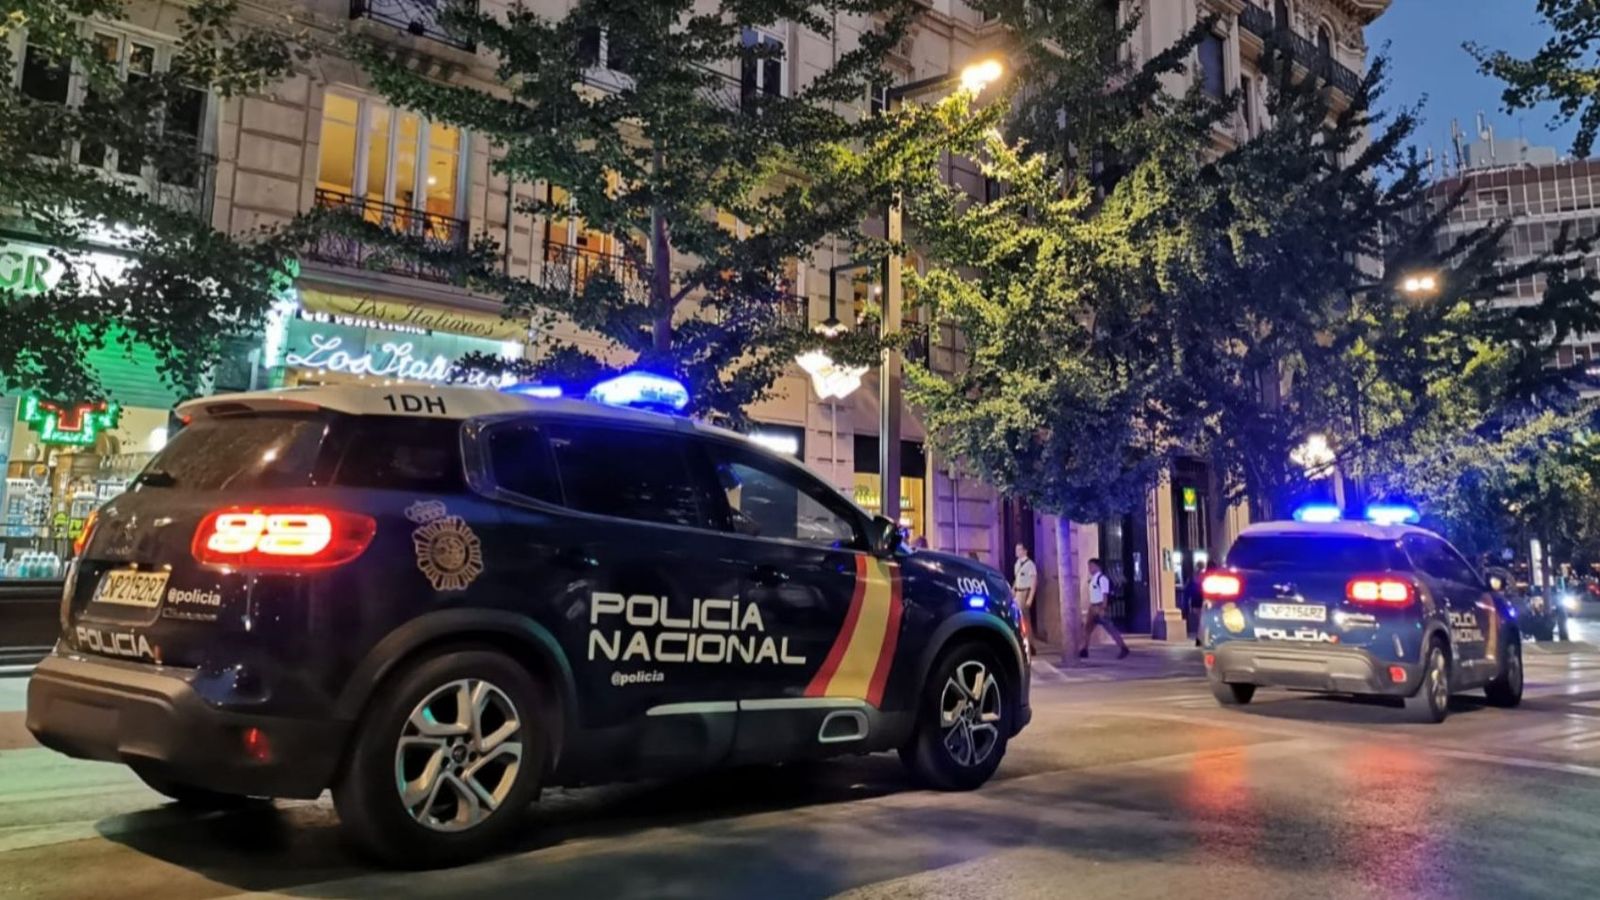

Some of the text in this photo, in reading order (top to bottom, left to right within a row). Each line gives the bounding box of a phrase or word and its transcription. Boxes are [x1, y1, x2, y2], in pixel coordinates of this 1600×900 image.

[336, 295, 494, 337] Los Italianos
[286, 333, 376, 376] Los
[384, 394, 447, 415] 1DH
[168, 587, 221, 606] @policia
[590, 592, 765, 632] POLICÍA
[75, 625, 155, 659] POLICÍA
[588, 629, 807, 665] NACIONAL
[611, 670, 665, 687] @policia
